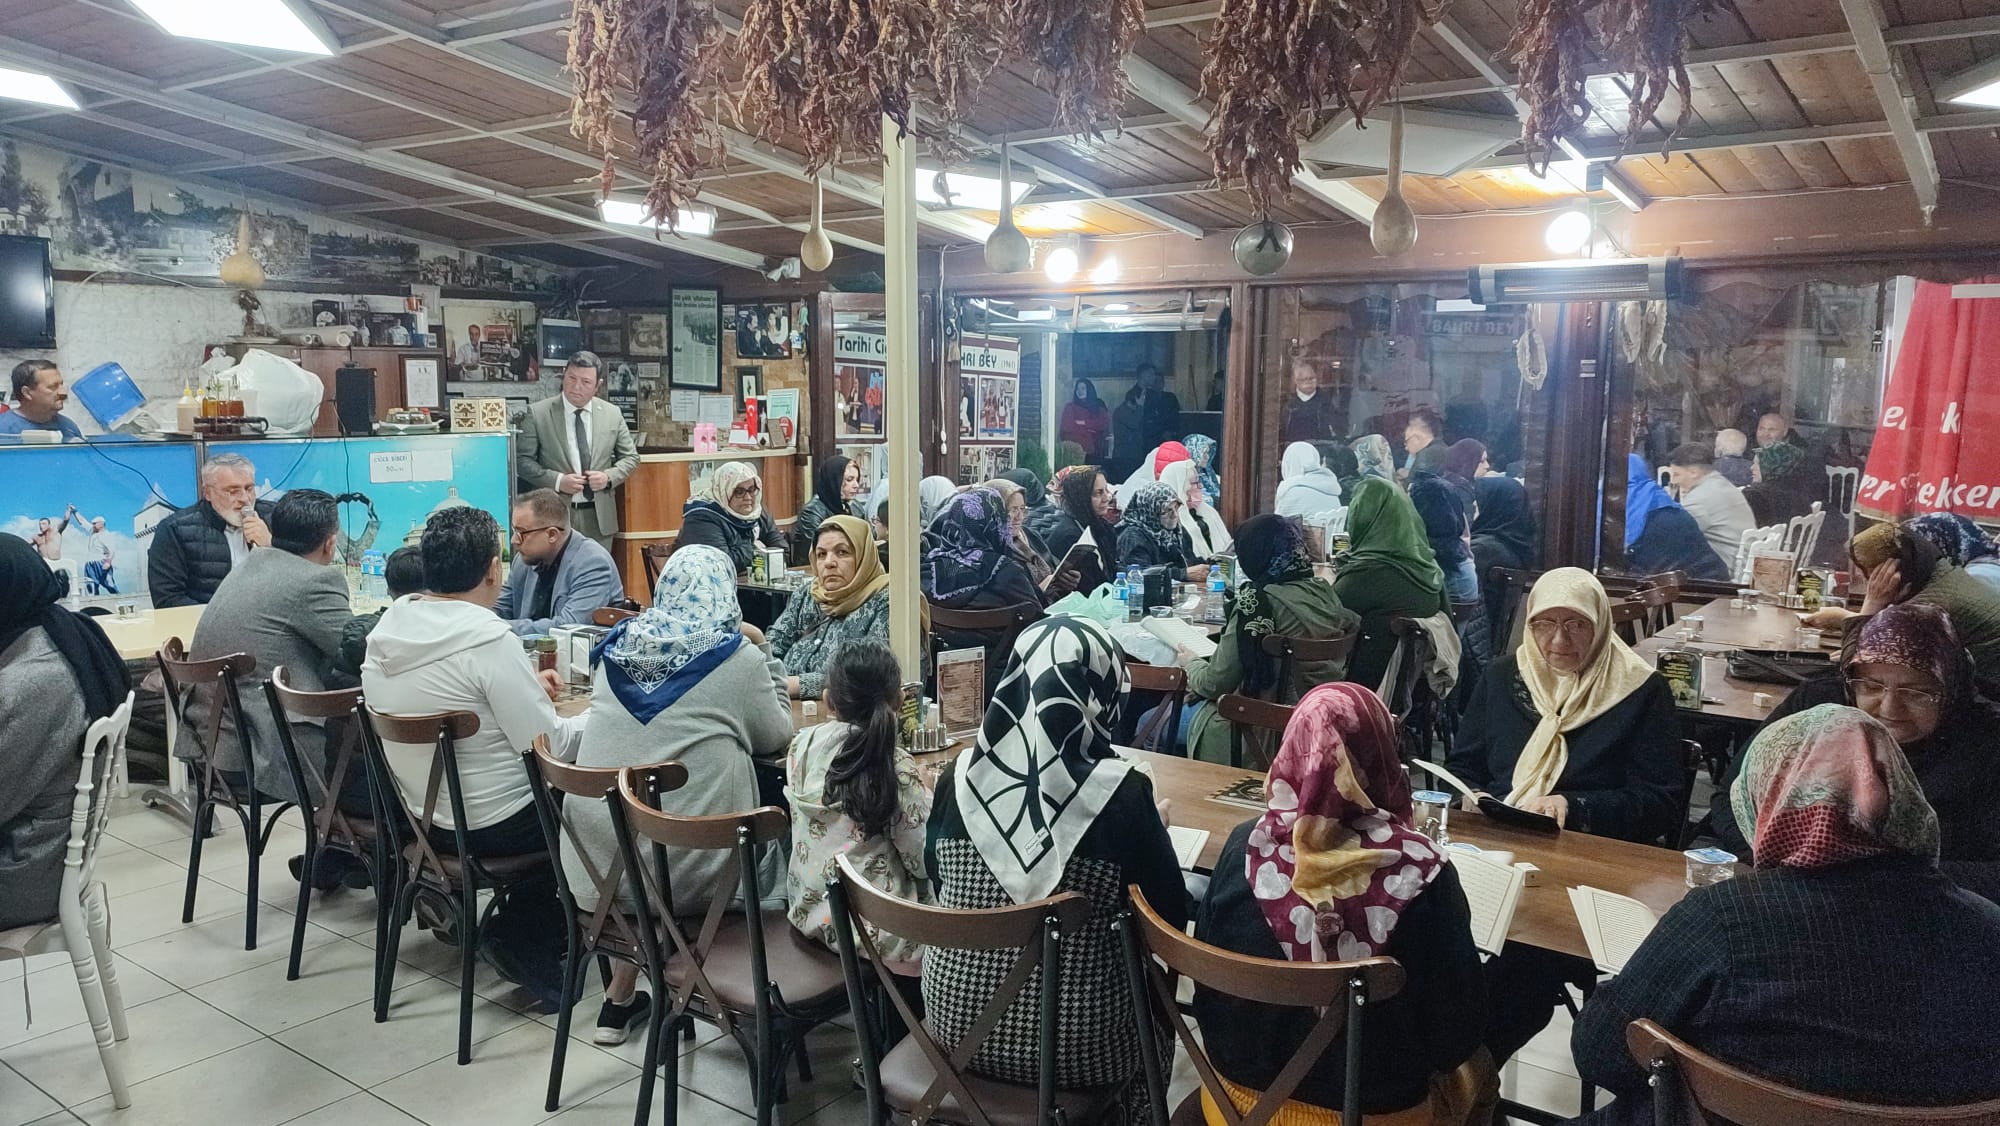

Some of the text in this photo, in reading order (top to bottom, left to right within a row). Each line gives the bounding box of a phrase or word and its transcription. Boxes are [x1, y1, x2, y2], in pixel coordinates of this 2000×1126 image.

[837, 335, 887, 355] Tarihi Ci
[979, 353, 997, 369] BEY
